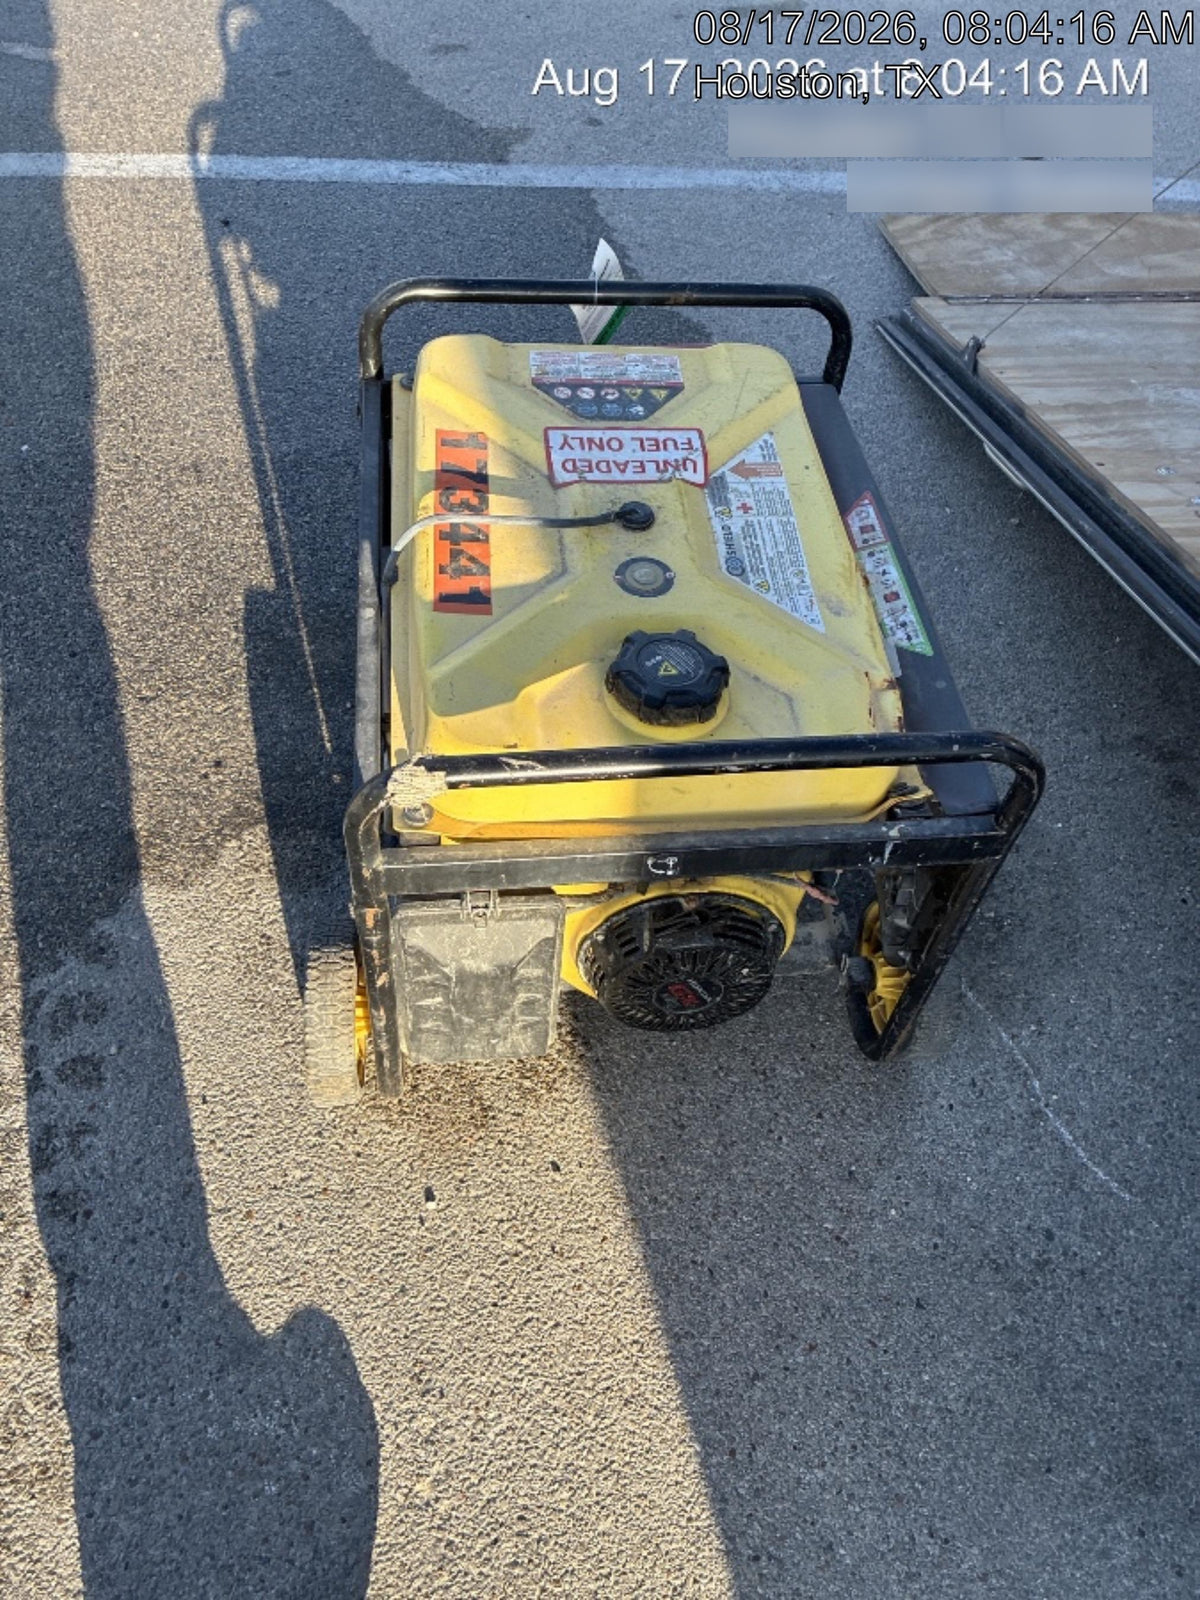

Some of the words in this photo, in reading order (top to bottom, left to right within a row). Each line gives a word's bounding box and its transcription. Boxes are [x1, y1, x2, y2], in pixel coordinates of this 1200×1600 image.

[559, 435, 625, 452] ONLY
[631, 437, 694, 452] FUEL
[561, 458, 698, 474] UNLEADED
[439, 433, 492, 604] 173441
